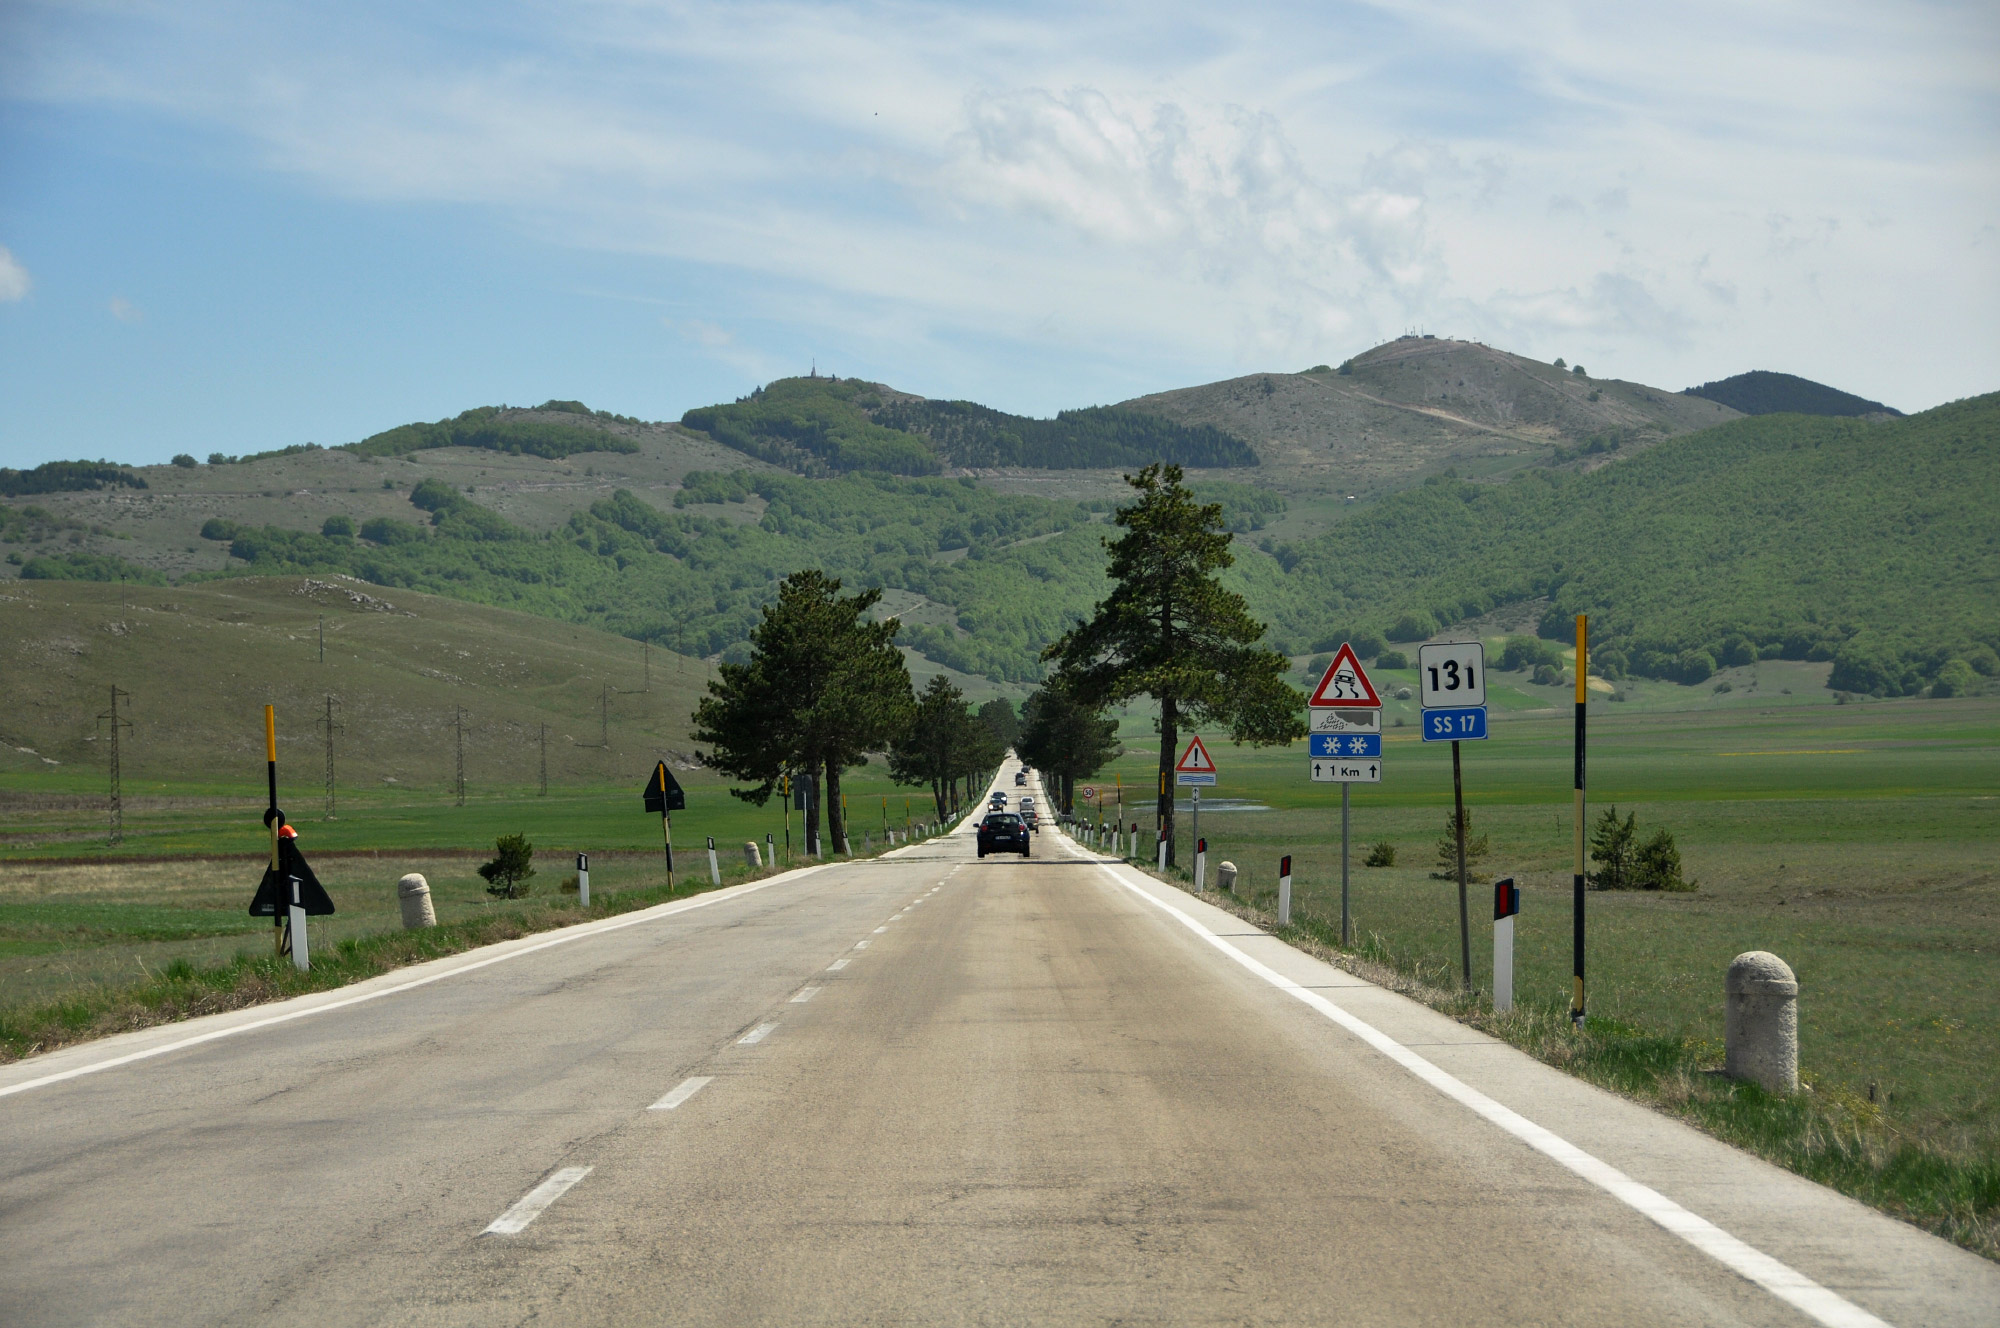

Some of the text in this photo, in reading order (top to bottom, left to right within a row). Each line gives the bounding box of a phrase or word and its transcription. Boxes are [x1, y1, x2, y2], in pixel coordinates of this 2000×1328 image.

[1427, 659, 1475, 692] 131
[1433, 715, 1475, 733] SS 17
[1329, 764, 1360, 777] 1 Km
